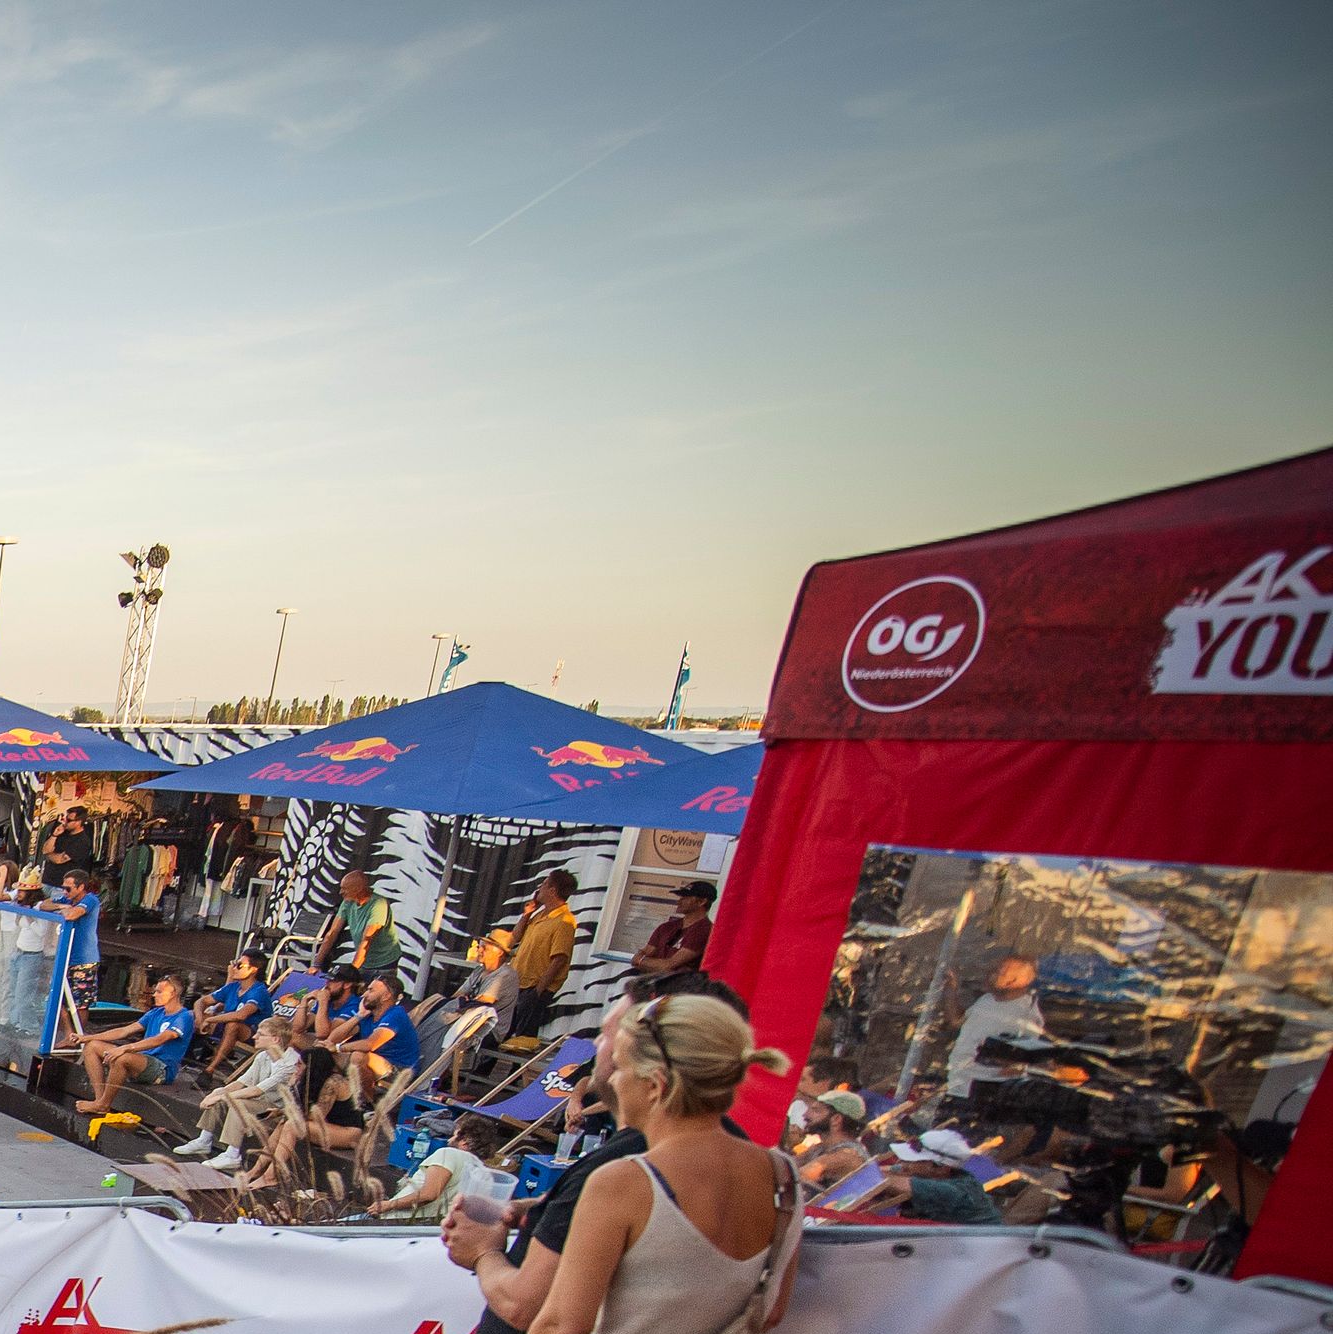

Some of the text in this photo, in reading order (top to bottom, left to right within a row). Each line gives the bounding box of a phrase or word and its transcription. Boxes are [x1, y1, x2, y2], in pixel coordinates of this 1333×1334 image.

[1203, 546, 1333, 607] AK
[851, 664, 955, 680] Niederösterreich
[38, 747, 91, 762] Bull
[248, 762, 389, 787] Red Bull
[680, 785, 752, 813] Re
[41, 1276, 103, 1326] AK
